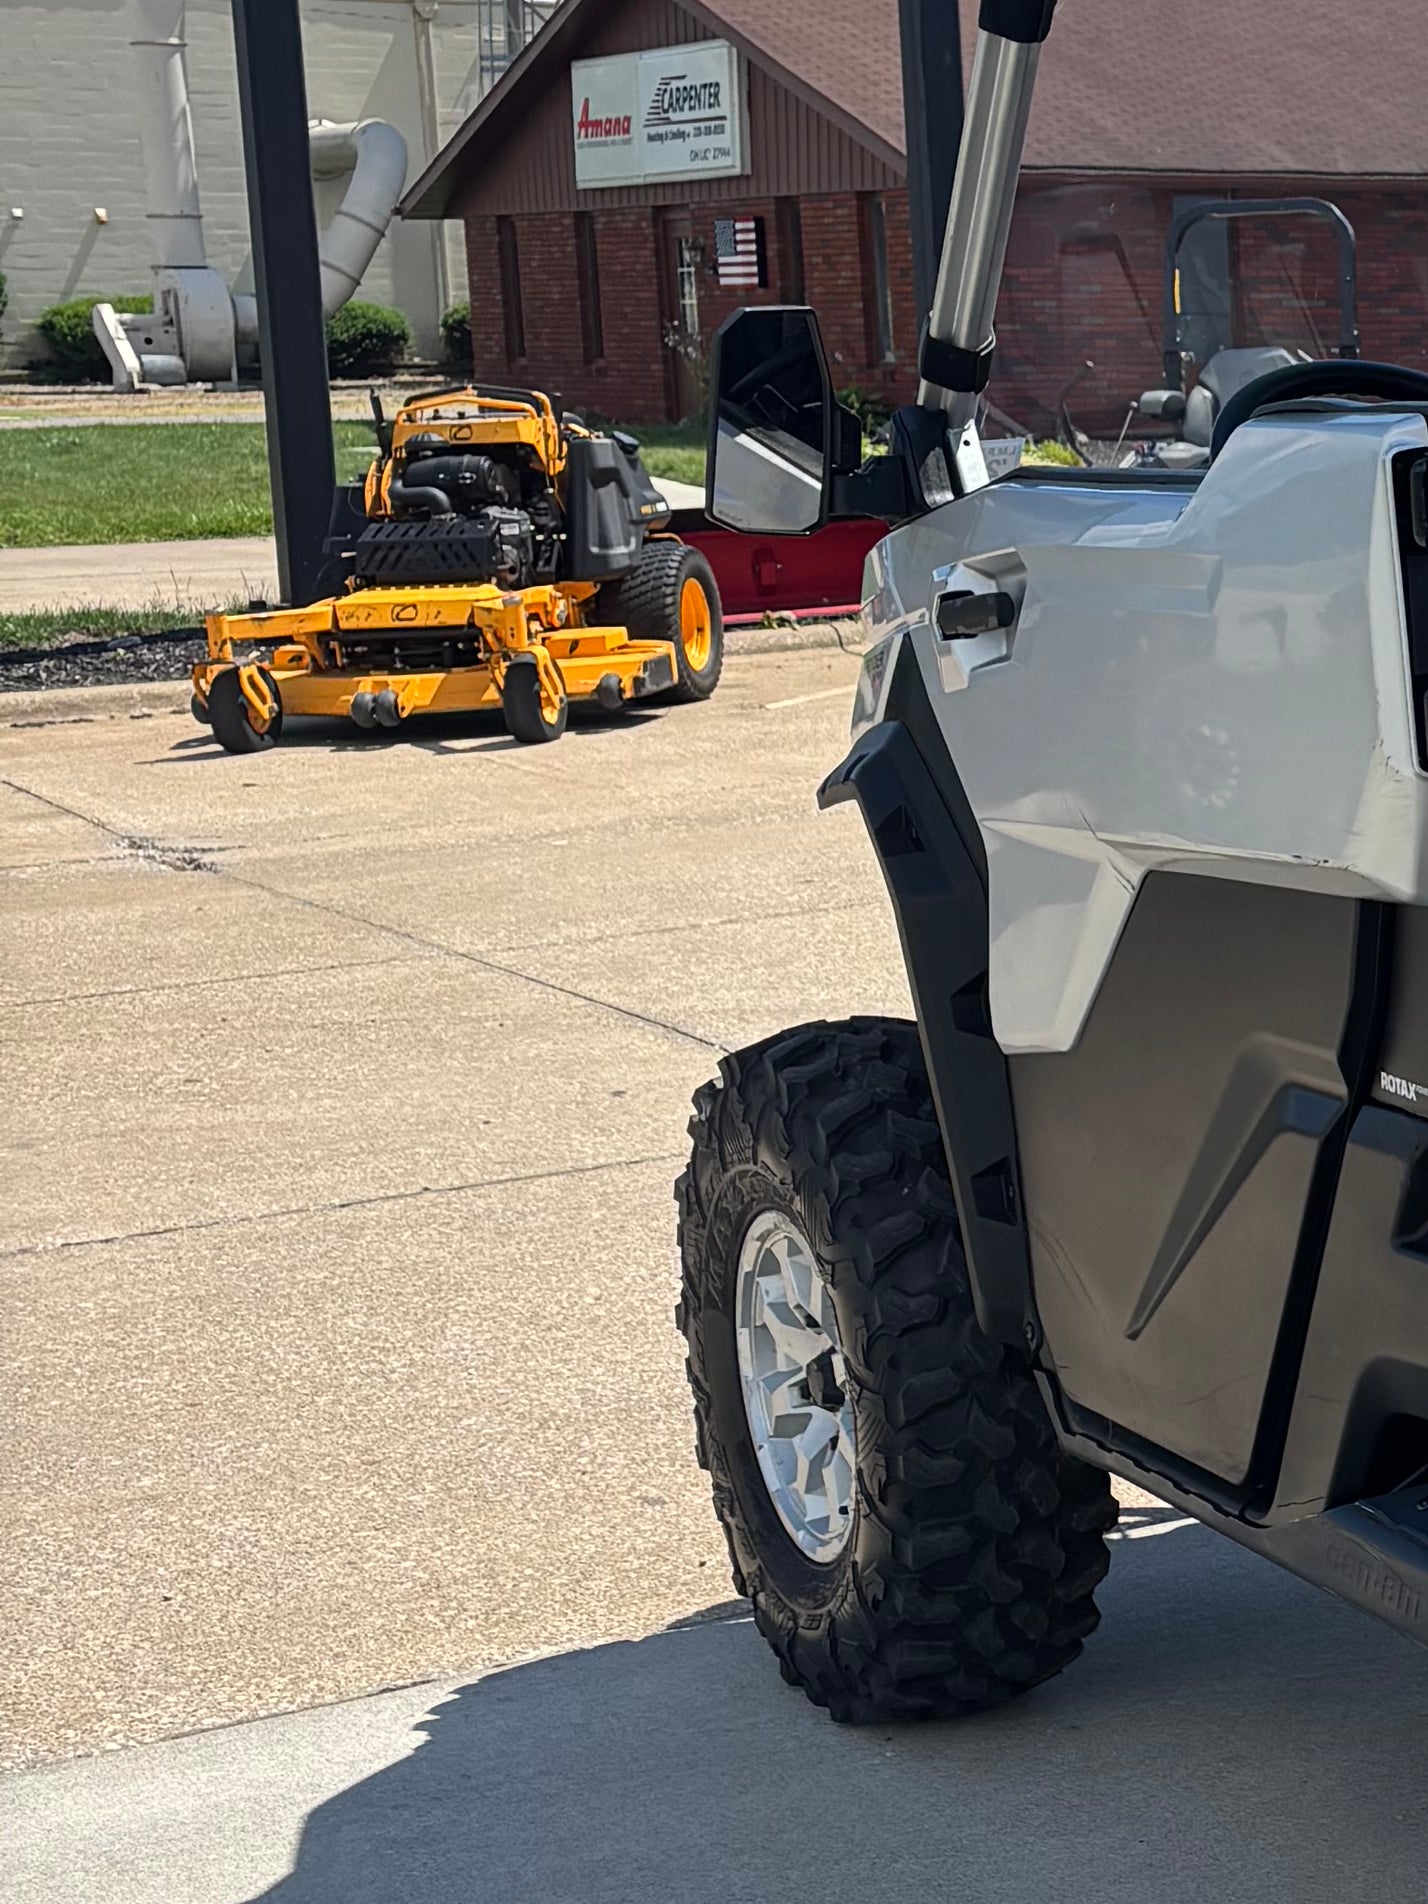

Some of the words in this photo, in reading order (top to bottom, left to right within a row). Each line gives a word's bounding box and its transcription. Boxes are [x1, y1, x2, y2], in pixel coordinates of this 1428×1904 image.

[661, 81, 721, 114] CARPENTER
[577, 97, 632, 140] Amana
[1380, 1071, 1418, 1102] ROTAX
